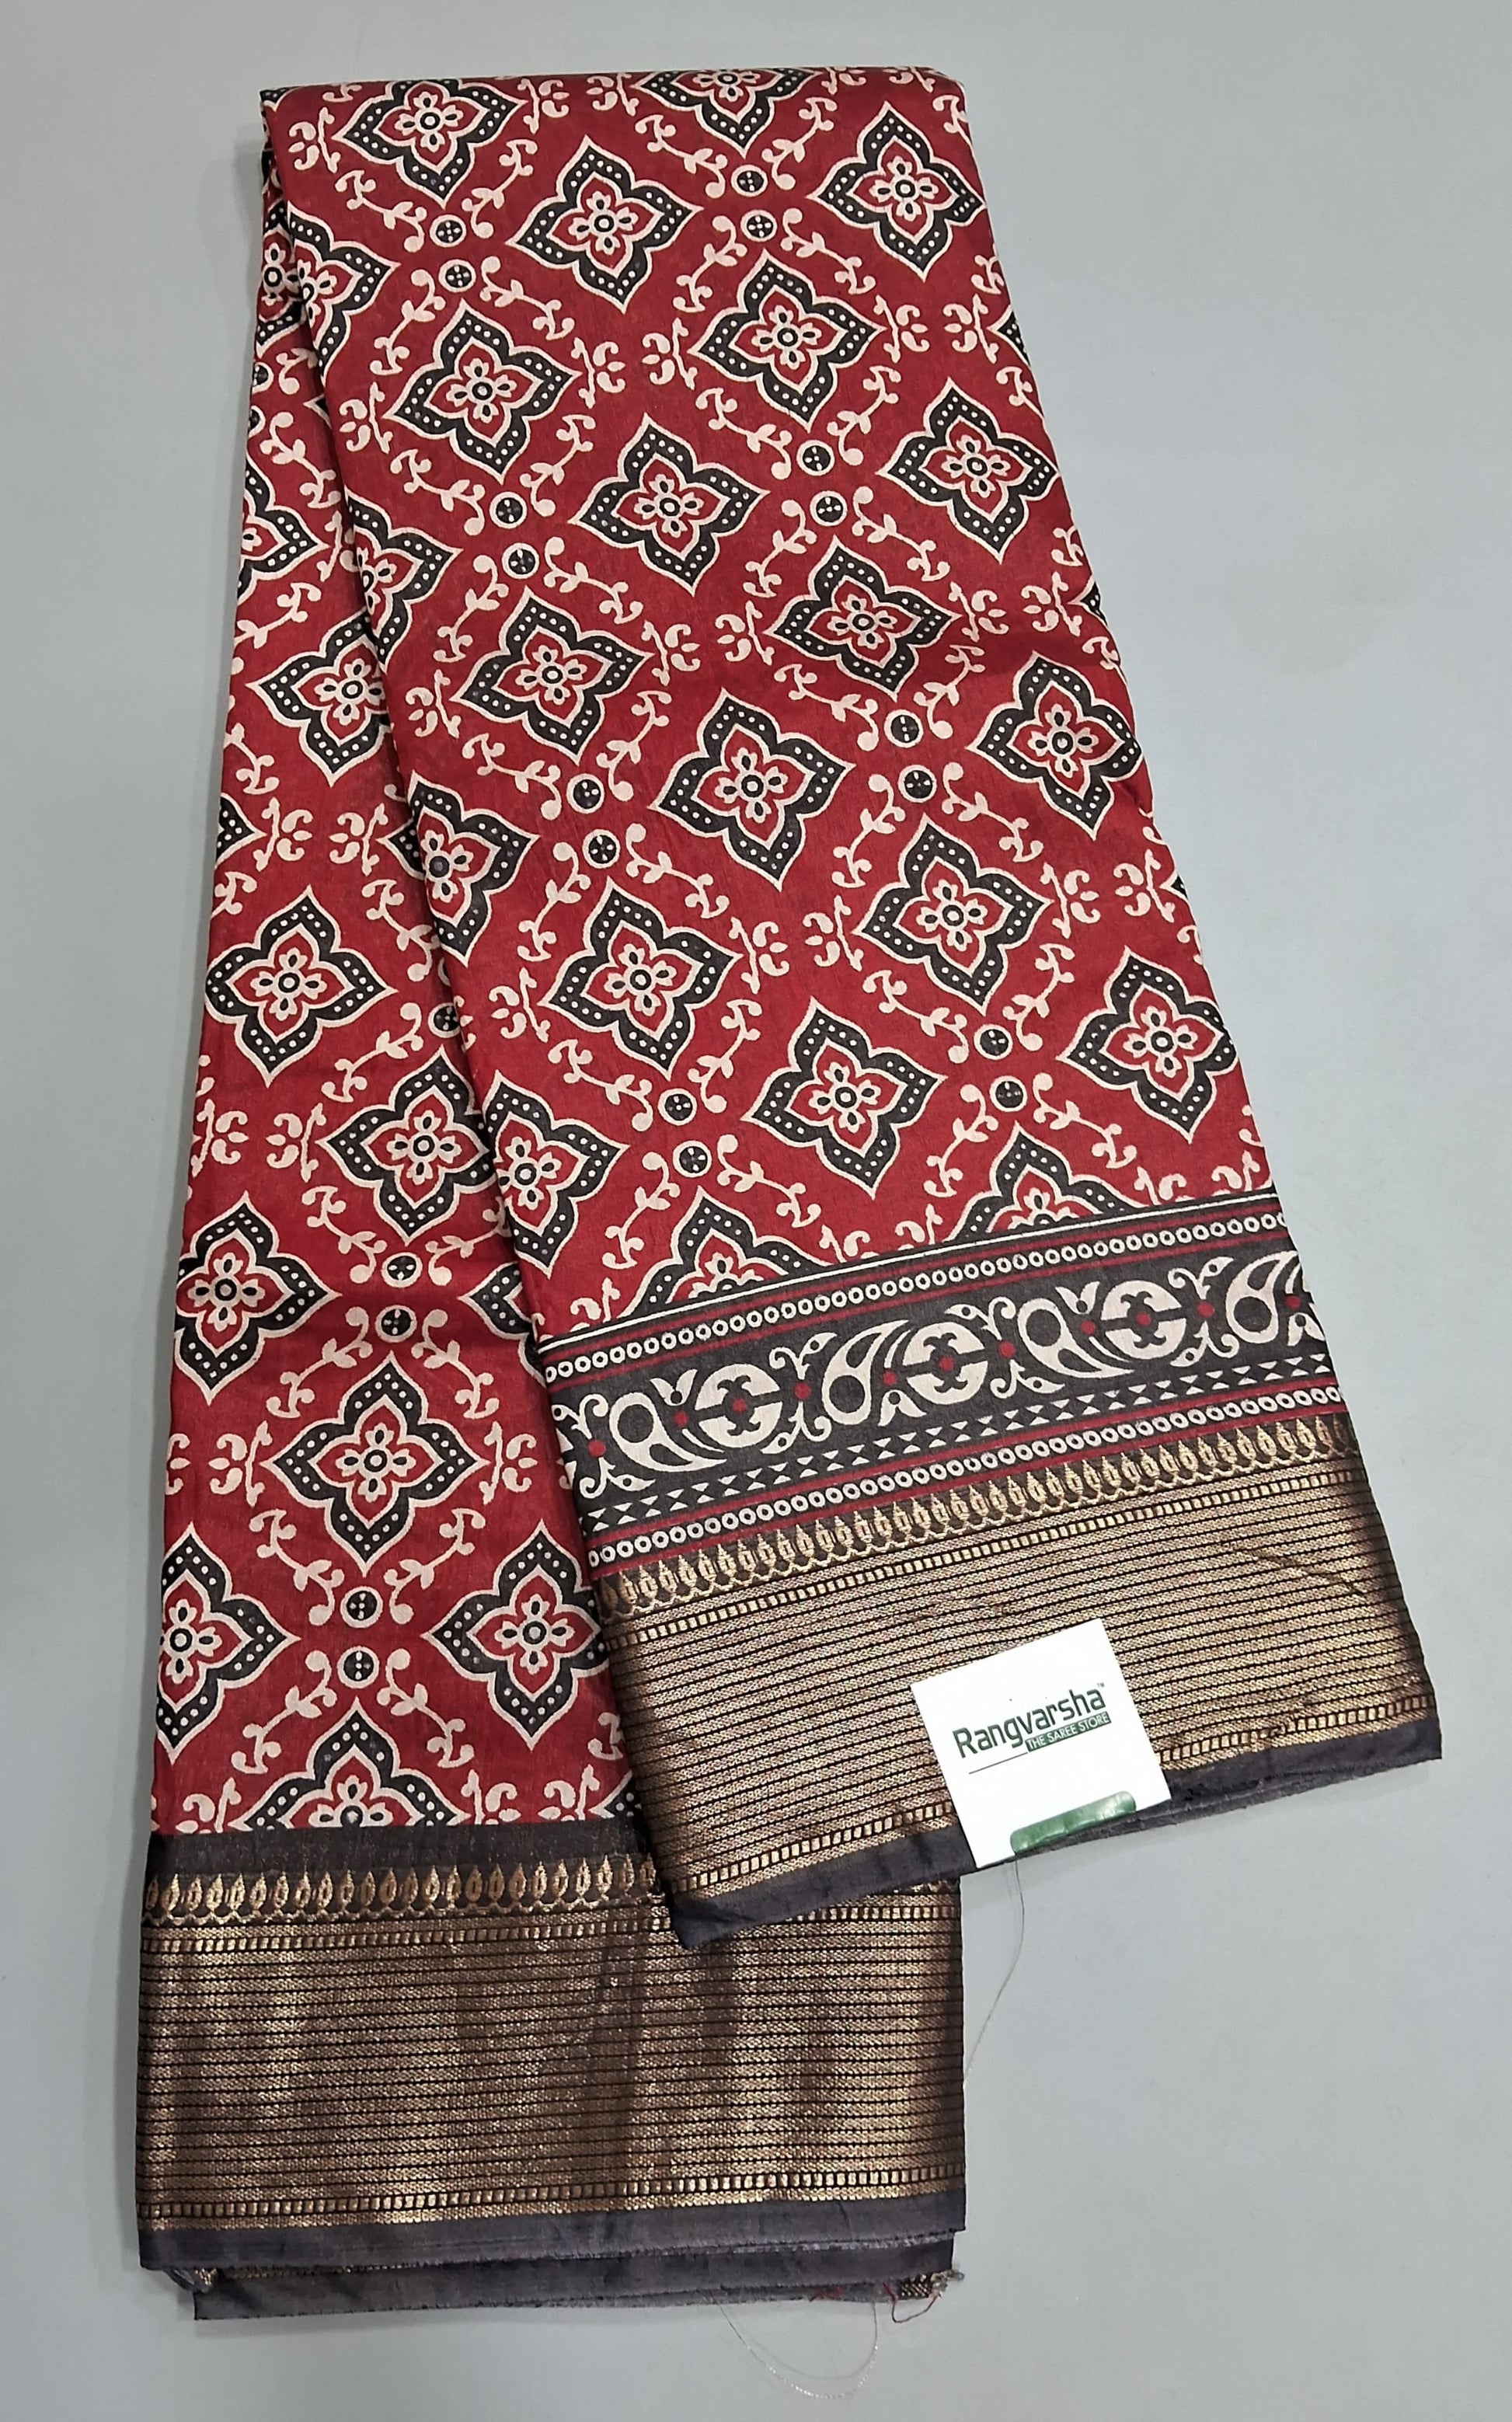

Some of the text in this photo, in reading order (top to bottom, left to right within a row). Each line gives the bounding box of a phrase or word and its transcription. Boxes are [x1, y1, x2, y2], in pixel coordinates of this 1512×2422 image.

[953, 1689, 1106, 1758] Rangvarsha
[1027, 1712, 1110, 1750] THE SAREE STORE
